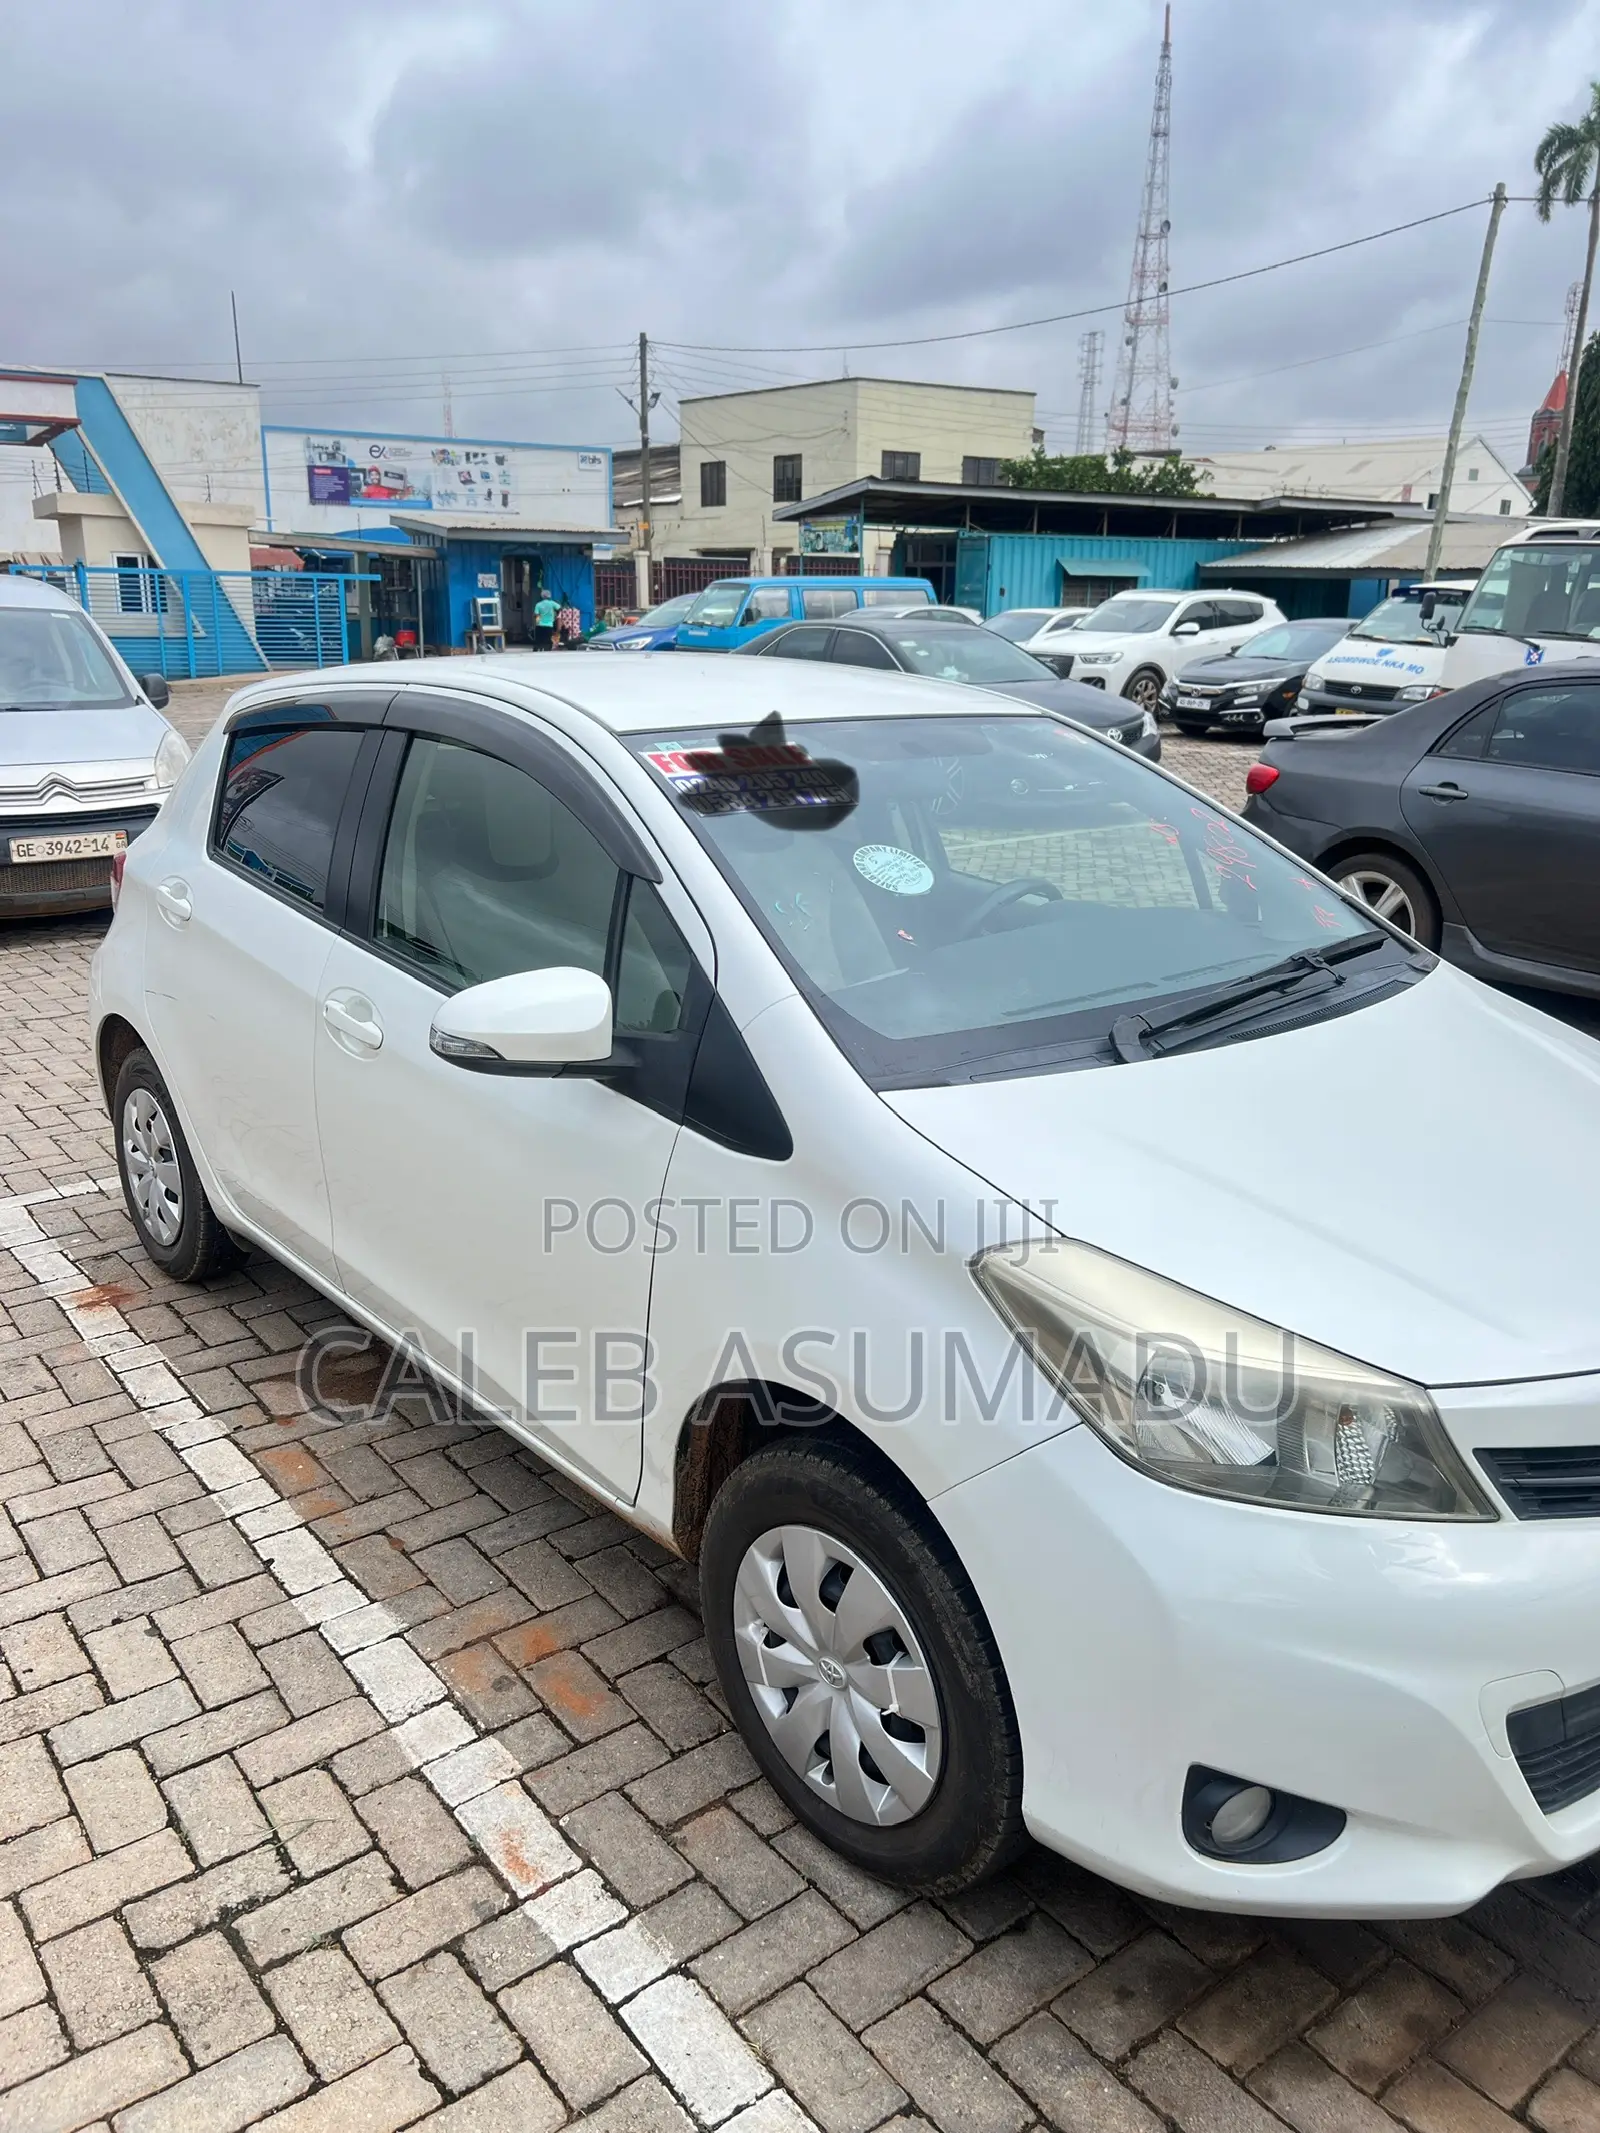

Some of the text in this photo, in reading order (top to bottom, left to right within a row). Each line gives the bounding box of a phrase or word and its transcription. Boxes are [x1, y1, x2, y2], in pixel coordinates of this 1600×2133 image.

[1381, 659, 1405, 669] NKA
[1407, 664, 1425, 675] MO
[16, 844, 37, 858] GE
[889, 847, 927, 869] LIMITED
